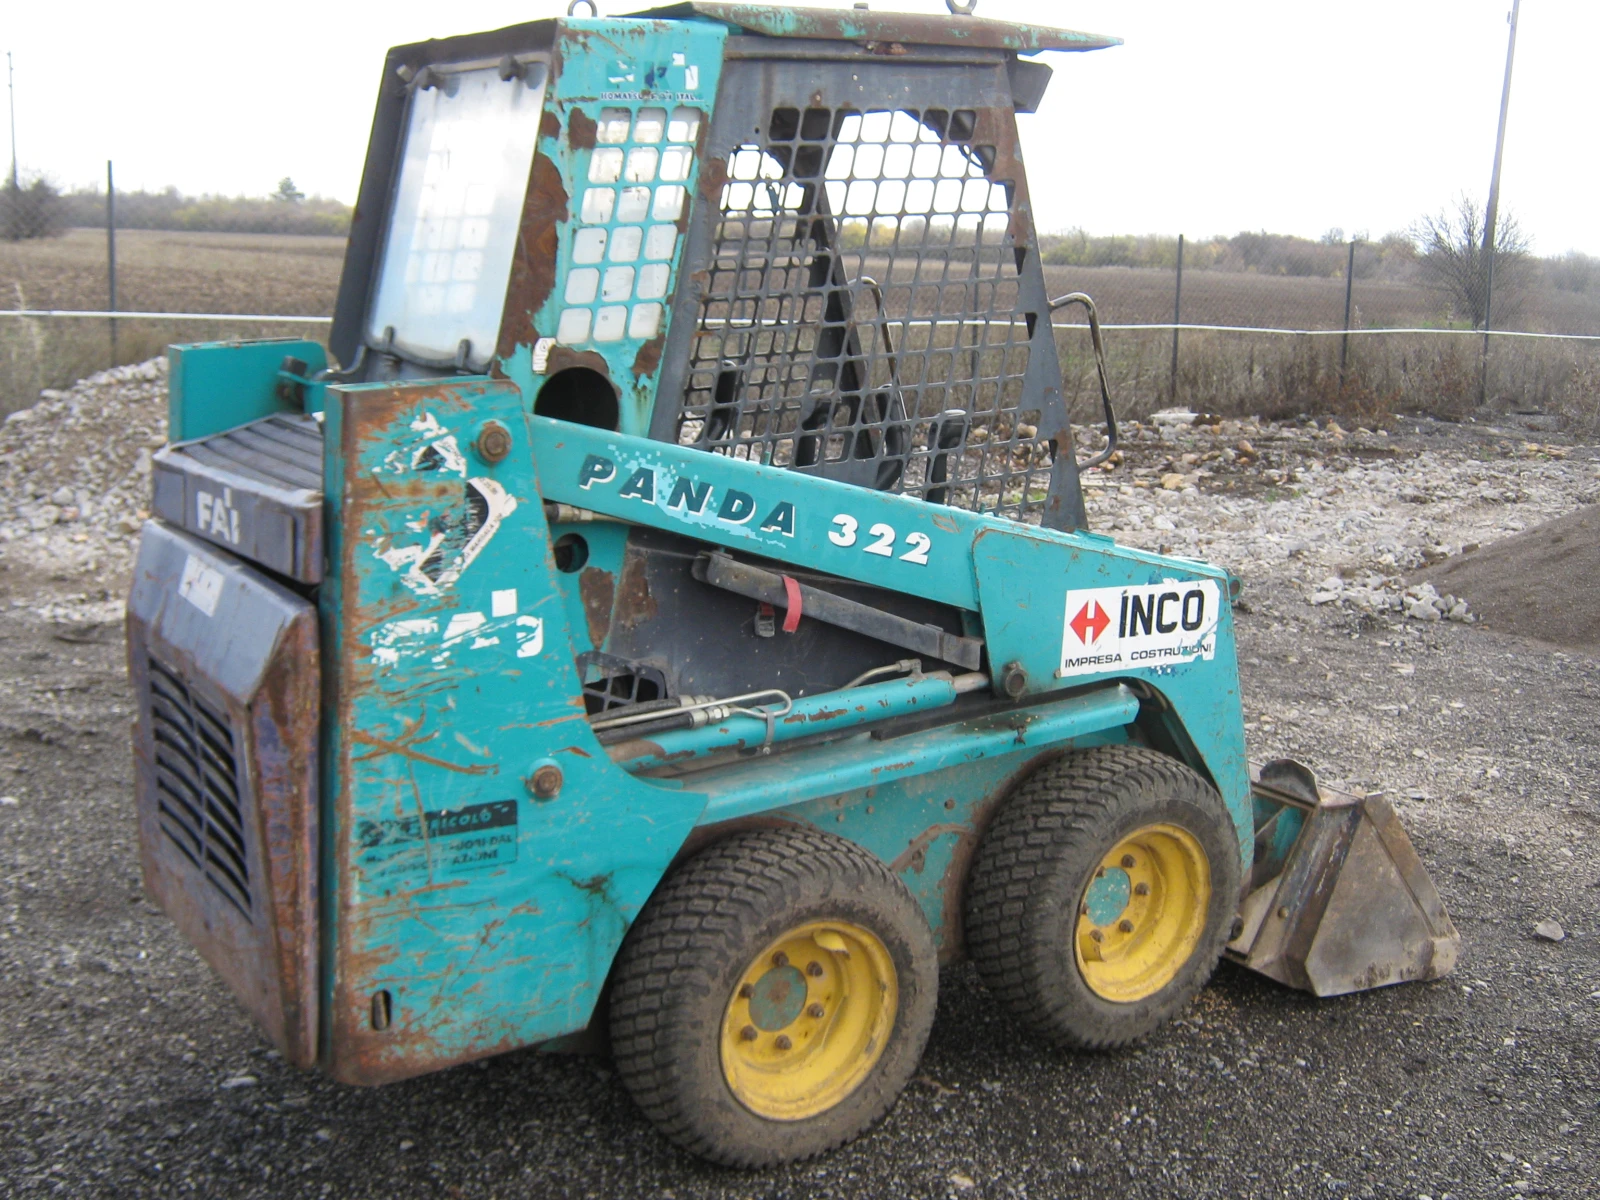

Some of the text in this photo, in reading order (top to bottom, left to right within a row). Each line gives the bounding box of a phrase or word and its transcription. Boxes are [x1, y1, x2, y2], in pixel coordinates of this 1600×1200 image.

[579, 454, 795, 538] PANDA
[827, 513, 932, 566] 322
[1119, 588, 1205, 639] INCO
[1065, 643, 1212, 669] IMPRESA COSTRUZIONI
